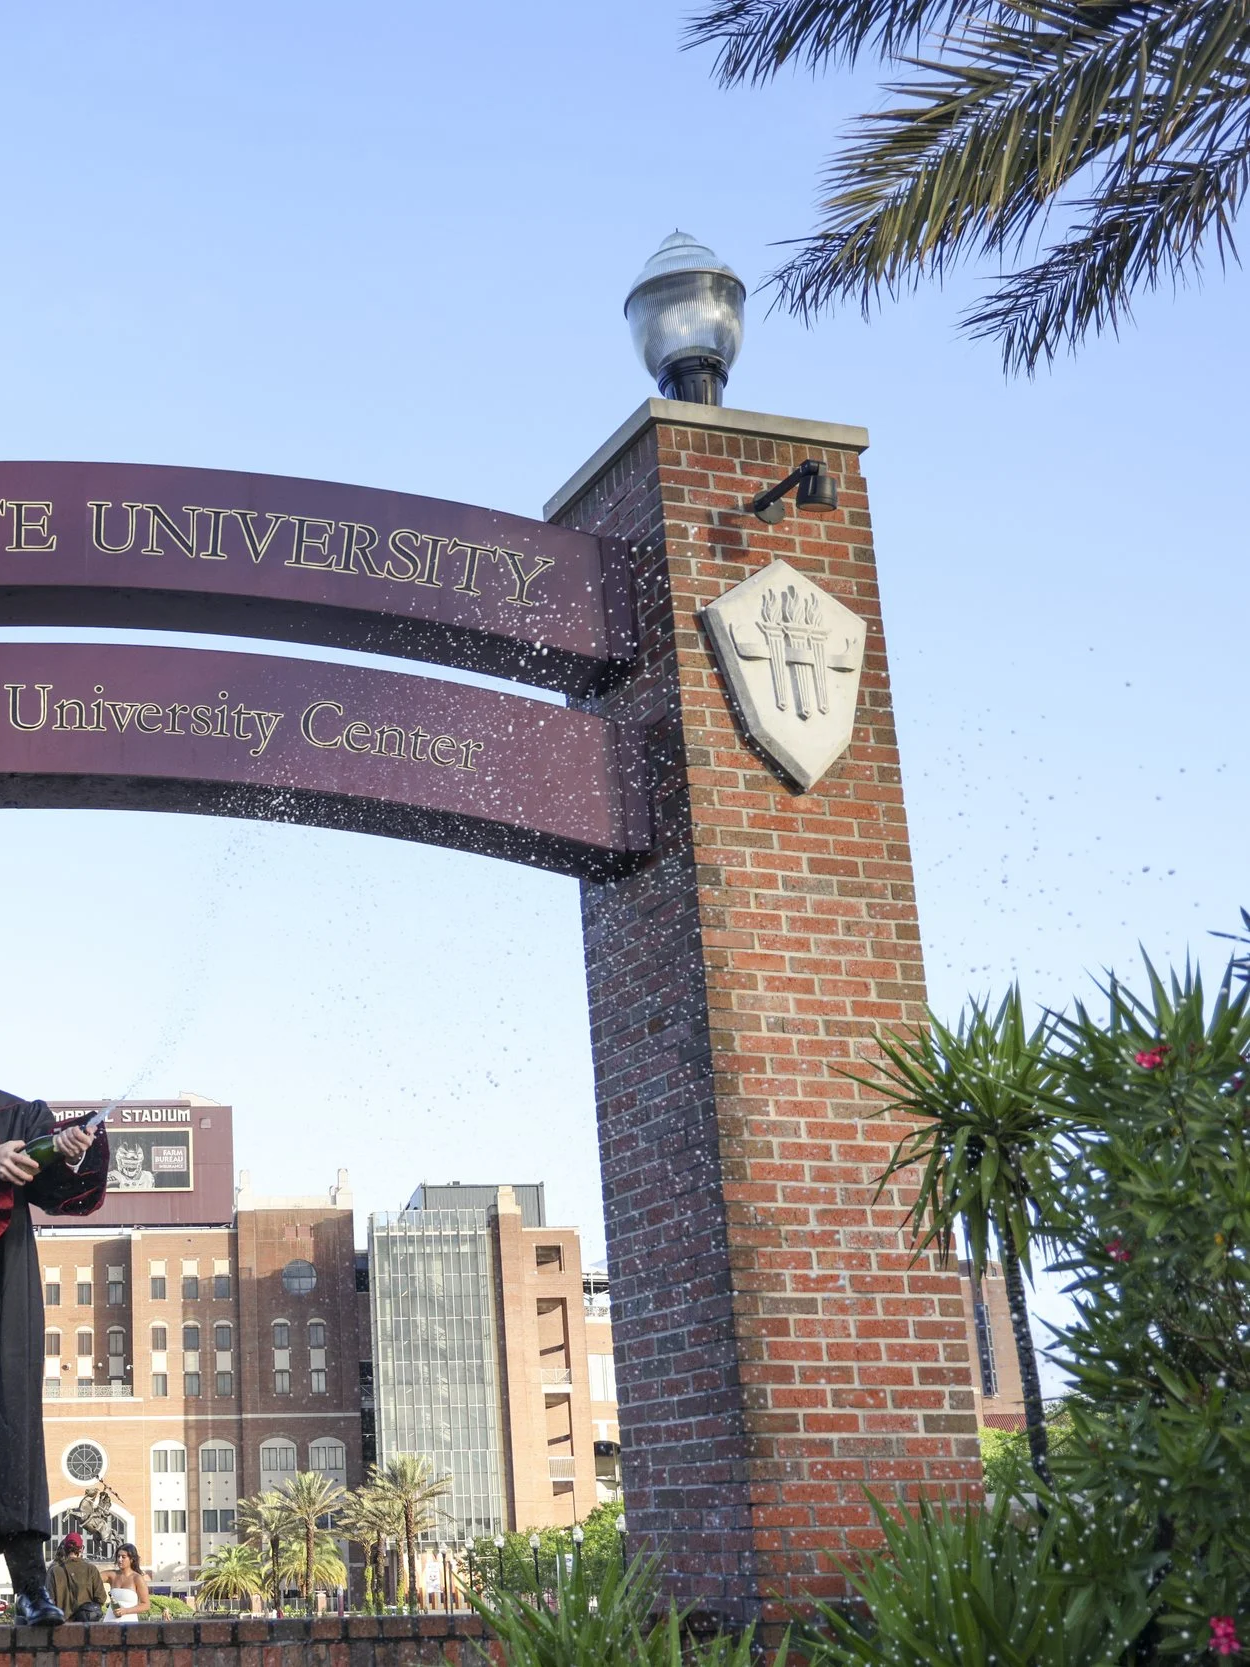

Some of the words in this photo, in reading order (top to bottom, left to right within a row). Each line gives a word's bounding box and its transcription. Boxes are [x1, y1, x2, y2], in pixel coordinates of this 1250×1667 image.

[87, 501, 555, 606] UNIVERSITY
[4, 684, 284, 757] University
[300, 700, 484, 771] Center
[122, 1109, 190, 1123] STADIUM
